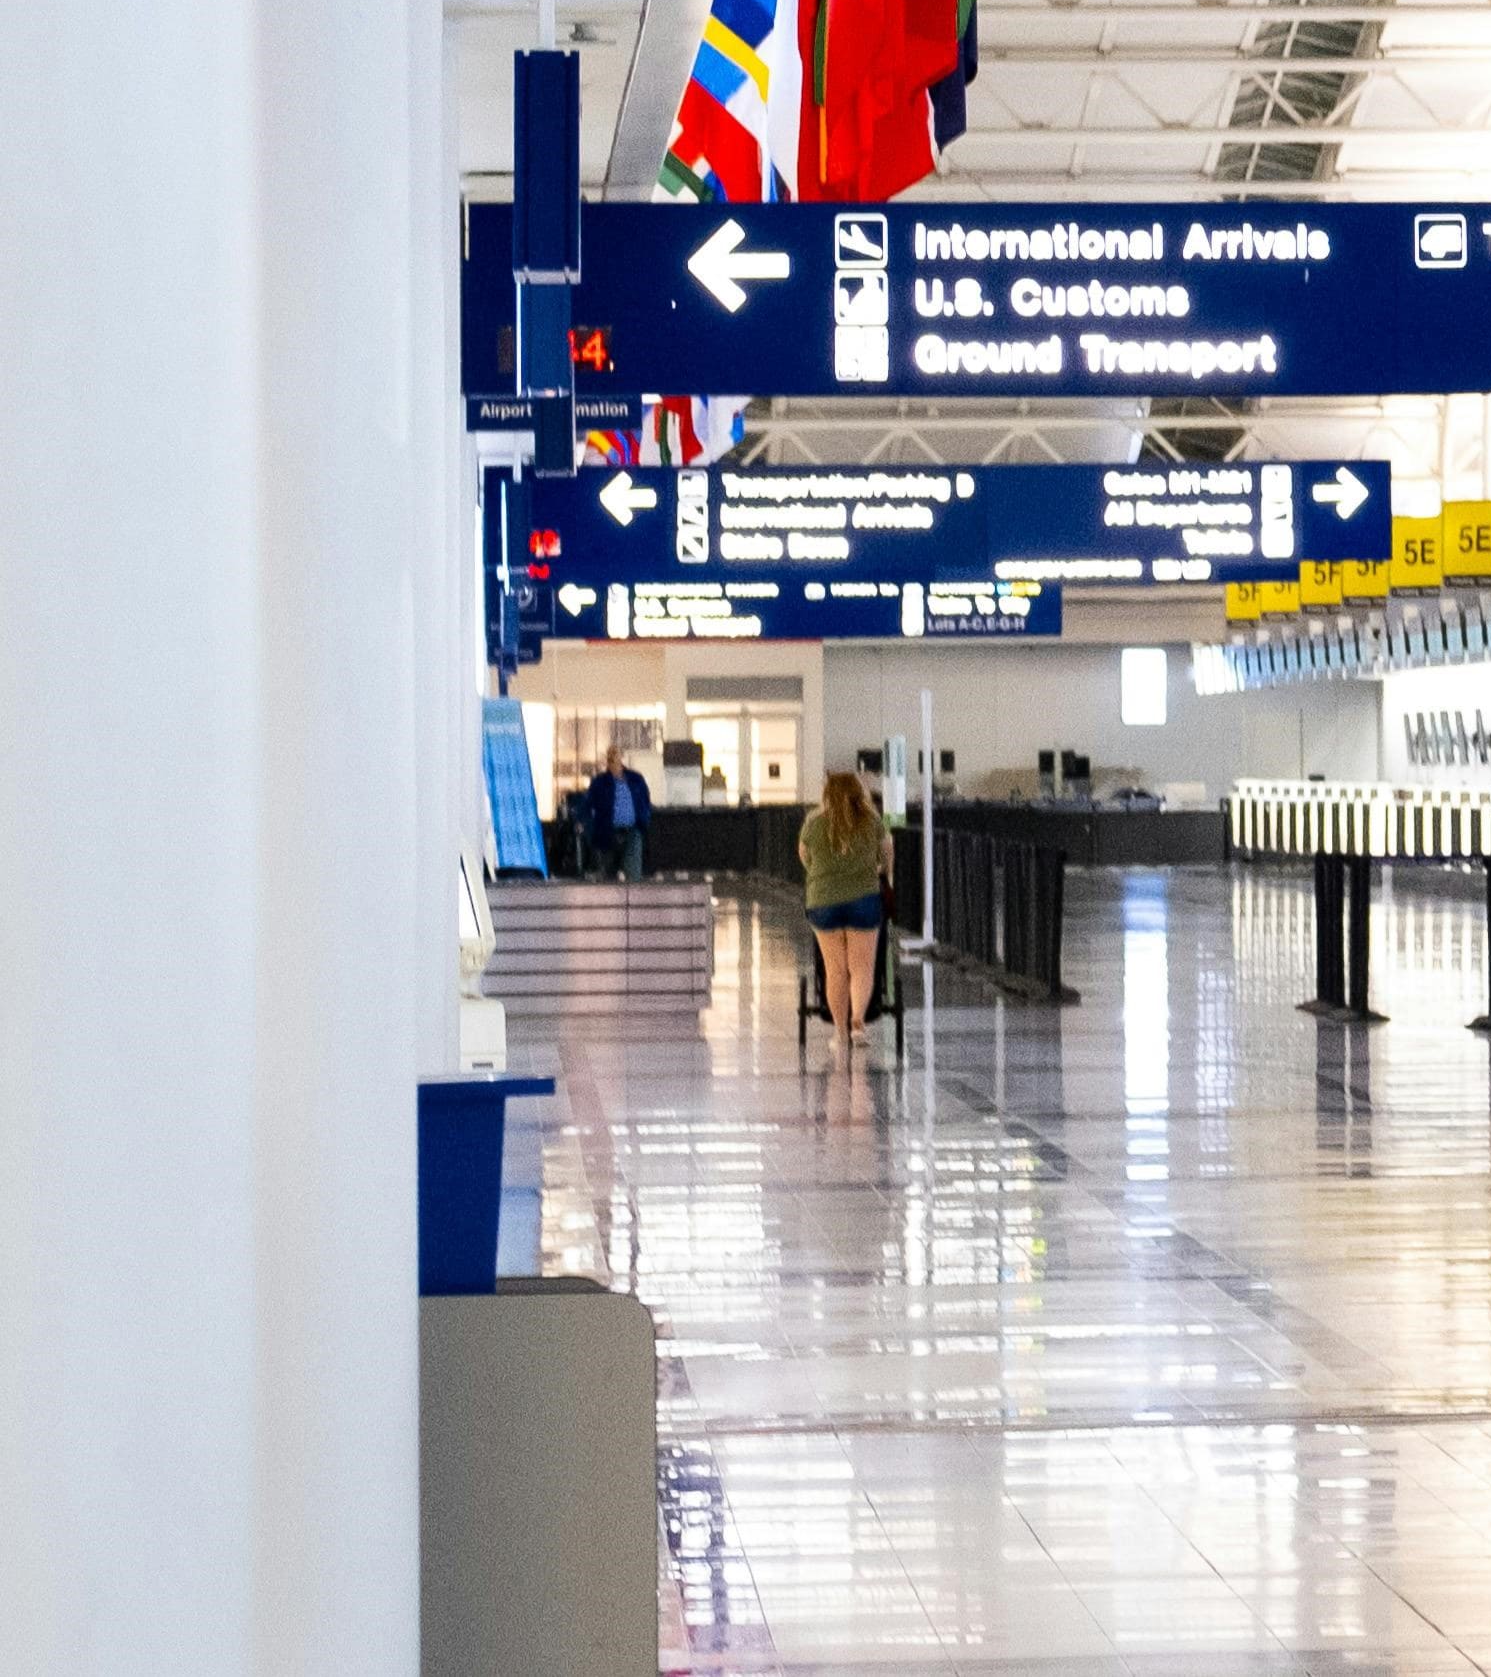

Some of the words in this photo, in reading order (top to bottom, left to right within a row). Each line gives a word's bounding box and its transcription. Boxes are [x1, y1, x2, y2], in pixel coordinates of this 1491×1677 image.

[914, 222, 1163, 262] International
[1183, 221, 1331, 261] Arrivals
[915, 279, 994, 318] U.S.
[1011, 278, 1190, 318] Customs
[914, 335, 1063, 376] Ground
[1080, 333, 1277, 380] Transport
[480, 403, 532, 418] Airport
[1404, 539, 1435, 565] 5E
[1458, 526, 1491, 553] 5E
